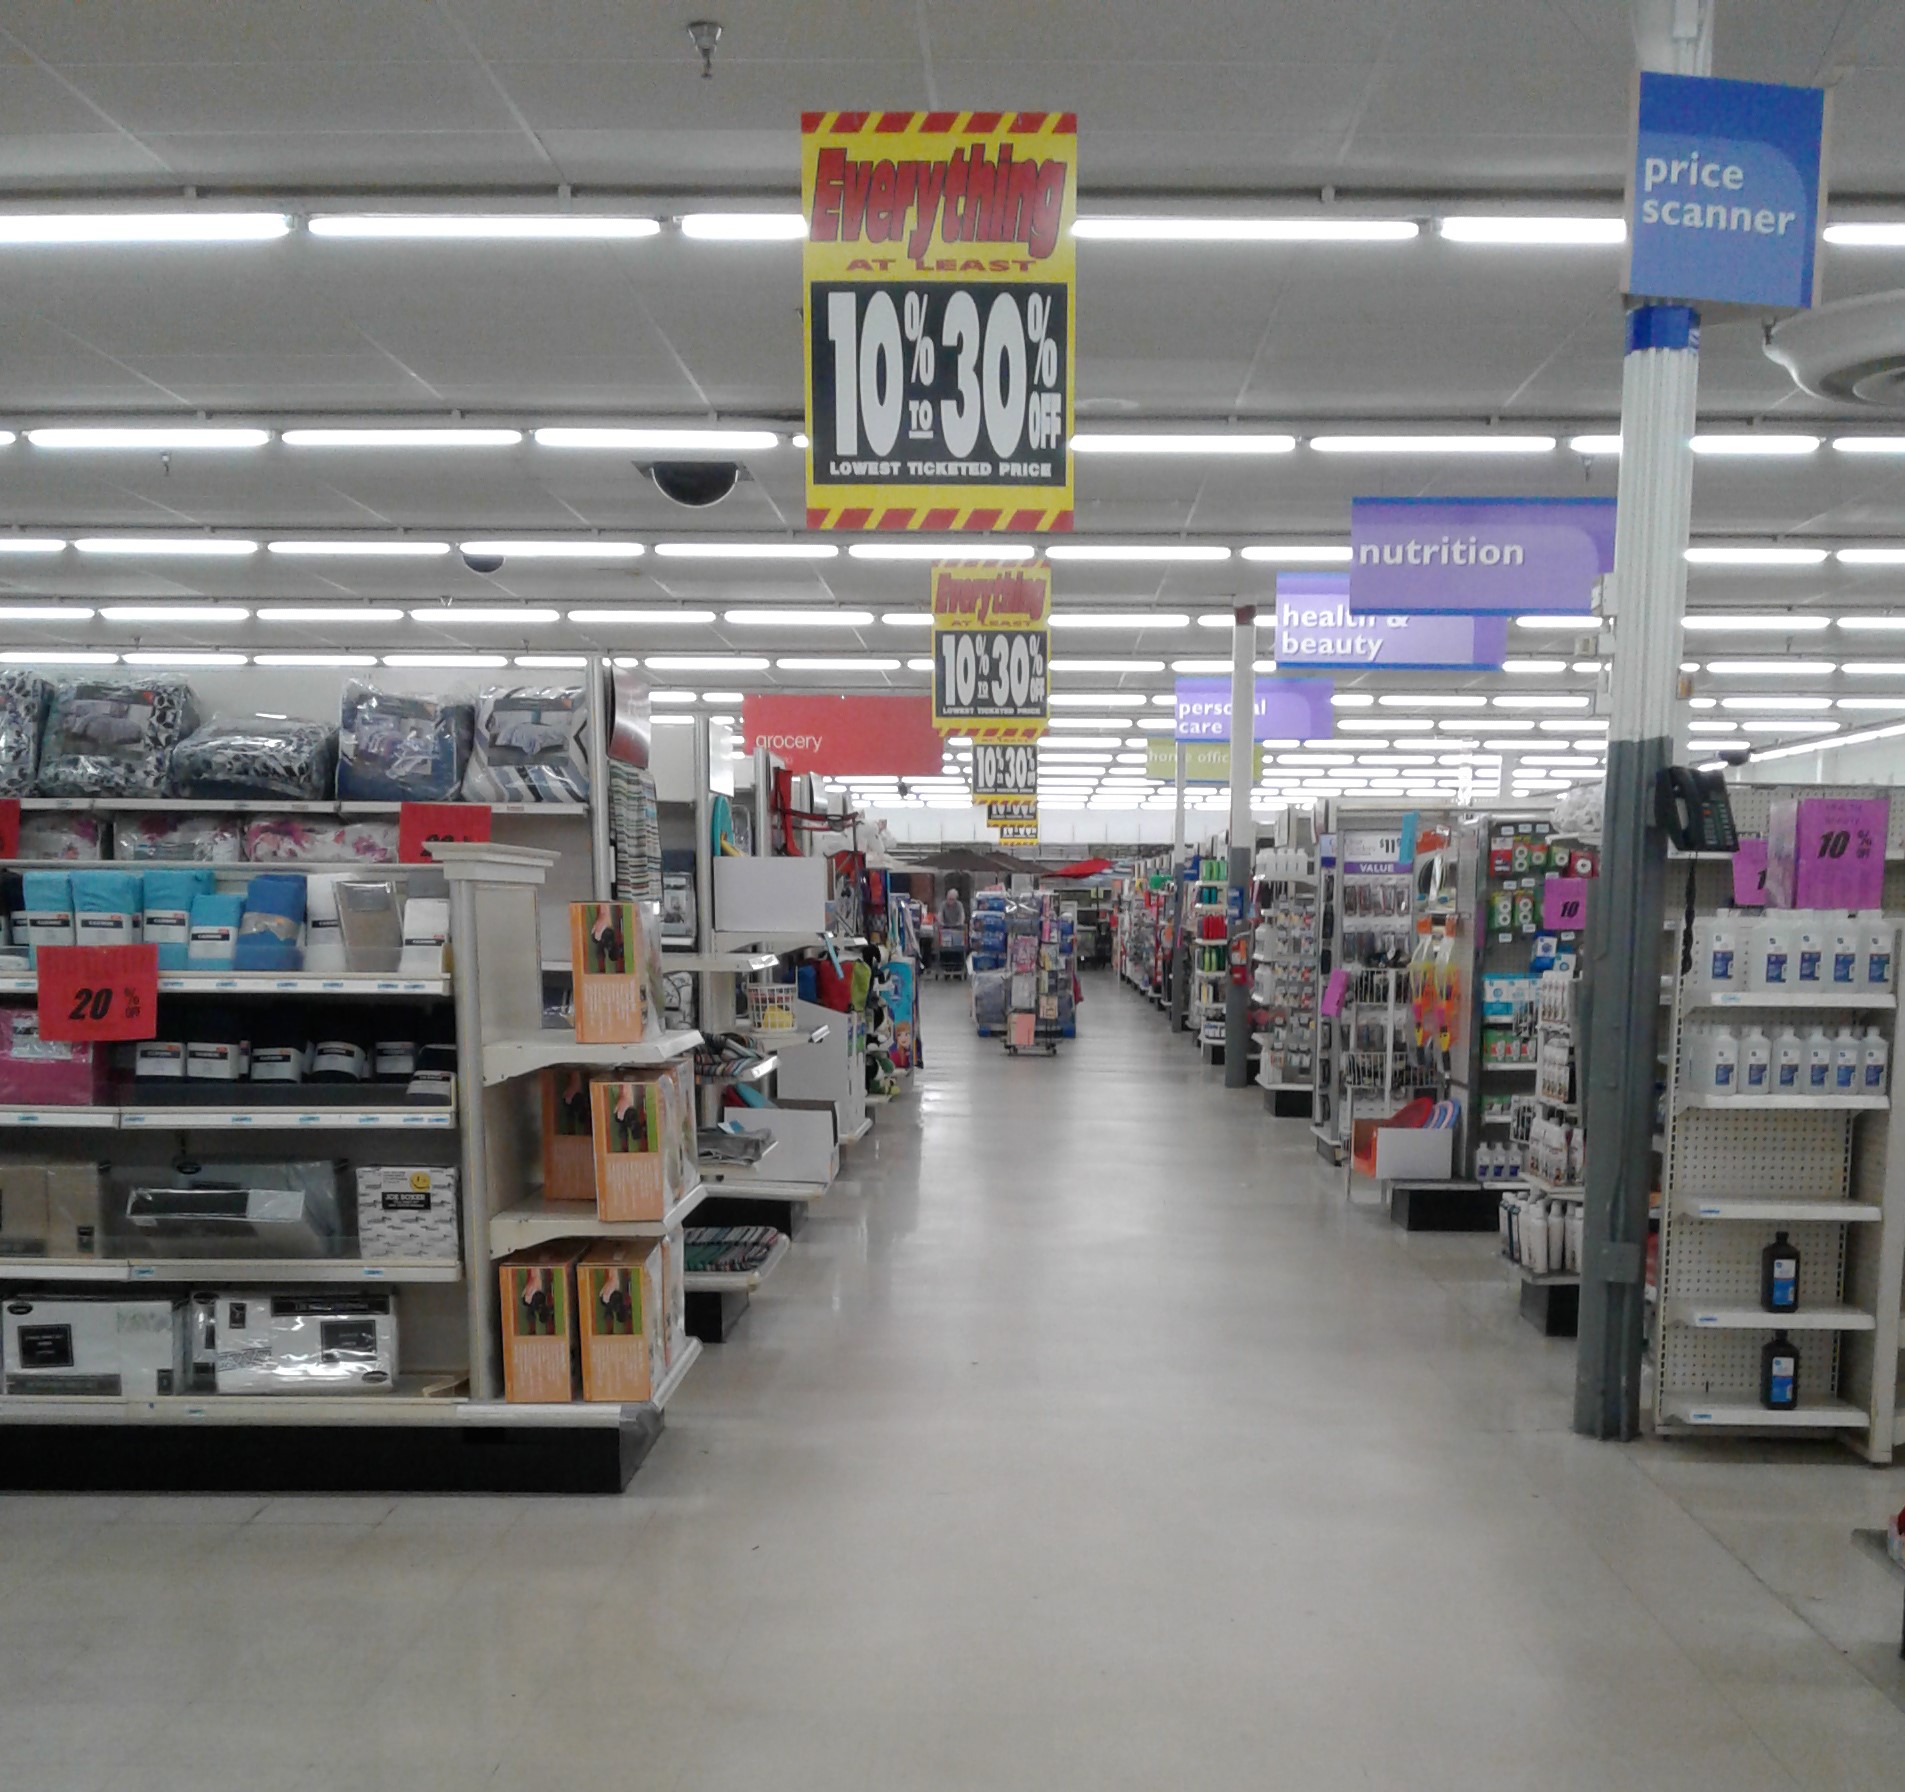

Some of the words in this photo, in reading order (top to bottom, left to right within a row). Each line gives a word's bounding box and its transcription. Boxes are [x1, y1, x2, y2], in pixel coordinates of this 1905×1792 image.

[1644, 151, 1744, 192] price
[810, 143, 1067, 258] Everything
[1642, 199, 1796, 235] scanner
[846, 259, 896, 271] AT
[915, 259, 1036, 272] LEAST
[909, 400, 933, 438] TO
[1029, 391, 1061, 450] OFF
[829, 461, 900, 476] LOWEST
[907, 462, 991, 477] TICKETED
[999, 462, 1051, 477] PRICE
[1359, 536, 1524, 566] nutrition
[1282, 630, 1383, 661] beauty
[1179, 699, 1266, 719] persol
[1179, 722, 1222, 734] care
[755, 735, 823, 753] grocery
[1198, 749, 1230, 764] offic
[1817, 831, 1850, 859] 10
[1360, 863, 1394, 873] VALUE
[1561, 901, 1580, 918] 10
[69, 988, 113, 1020] 20
